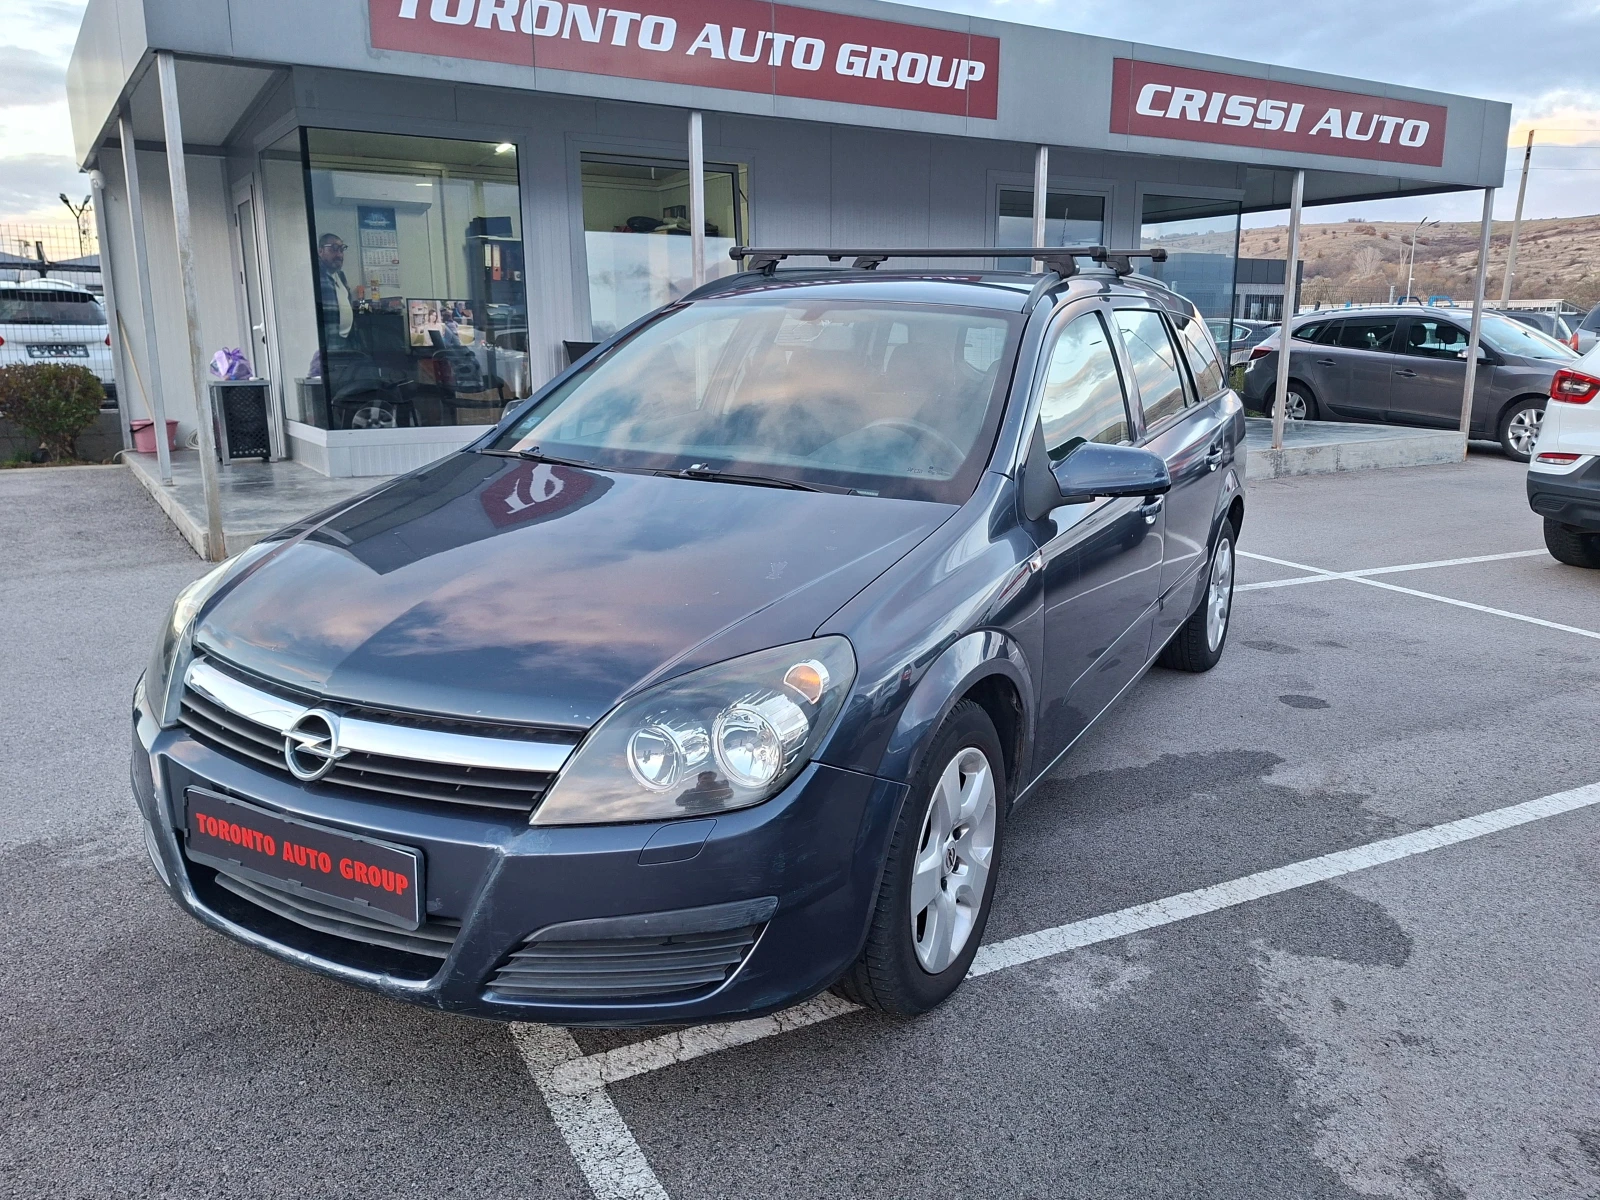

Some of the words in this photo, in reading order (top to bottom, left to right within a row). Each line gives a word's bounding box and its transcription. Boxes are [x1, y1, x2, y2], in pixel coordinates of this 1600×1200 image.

[685, 22, 826, 72] AUTO
[835, 43, 986, 90] GROUP
[1135, 83, 1306, 133] CRISSI
[1308, 107, 1430, 148] AUTO
[195, 812, 276, 856] TORONTO
[282, 841, 332, 874] AUTO
[339, 857, 409, 896] GROUP
